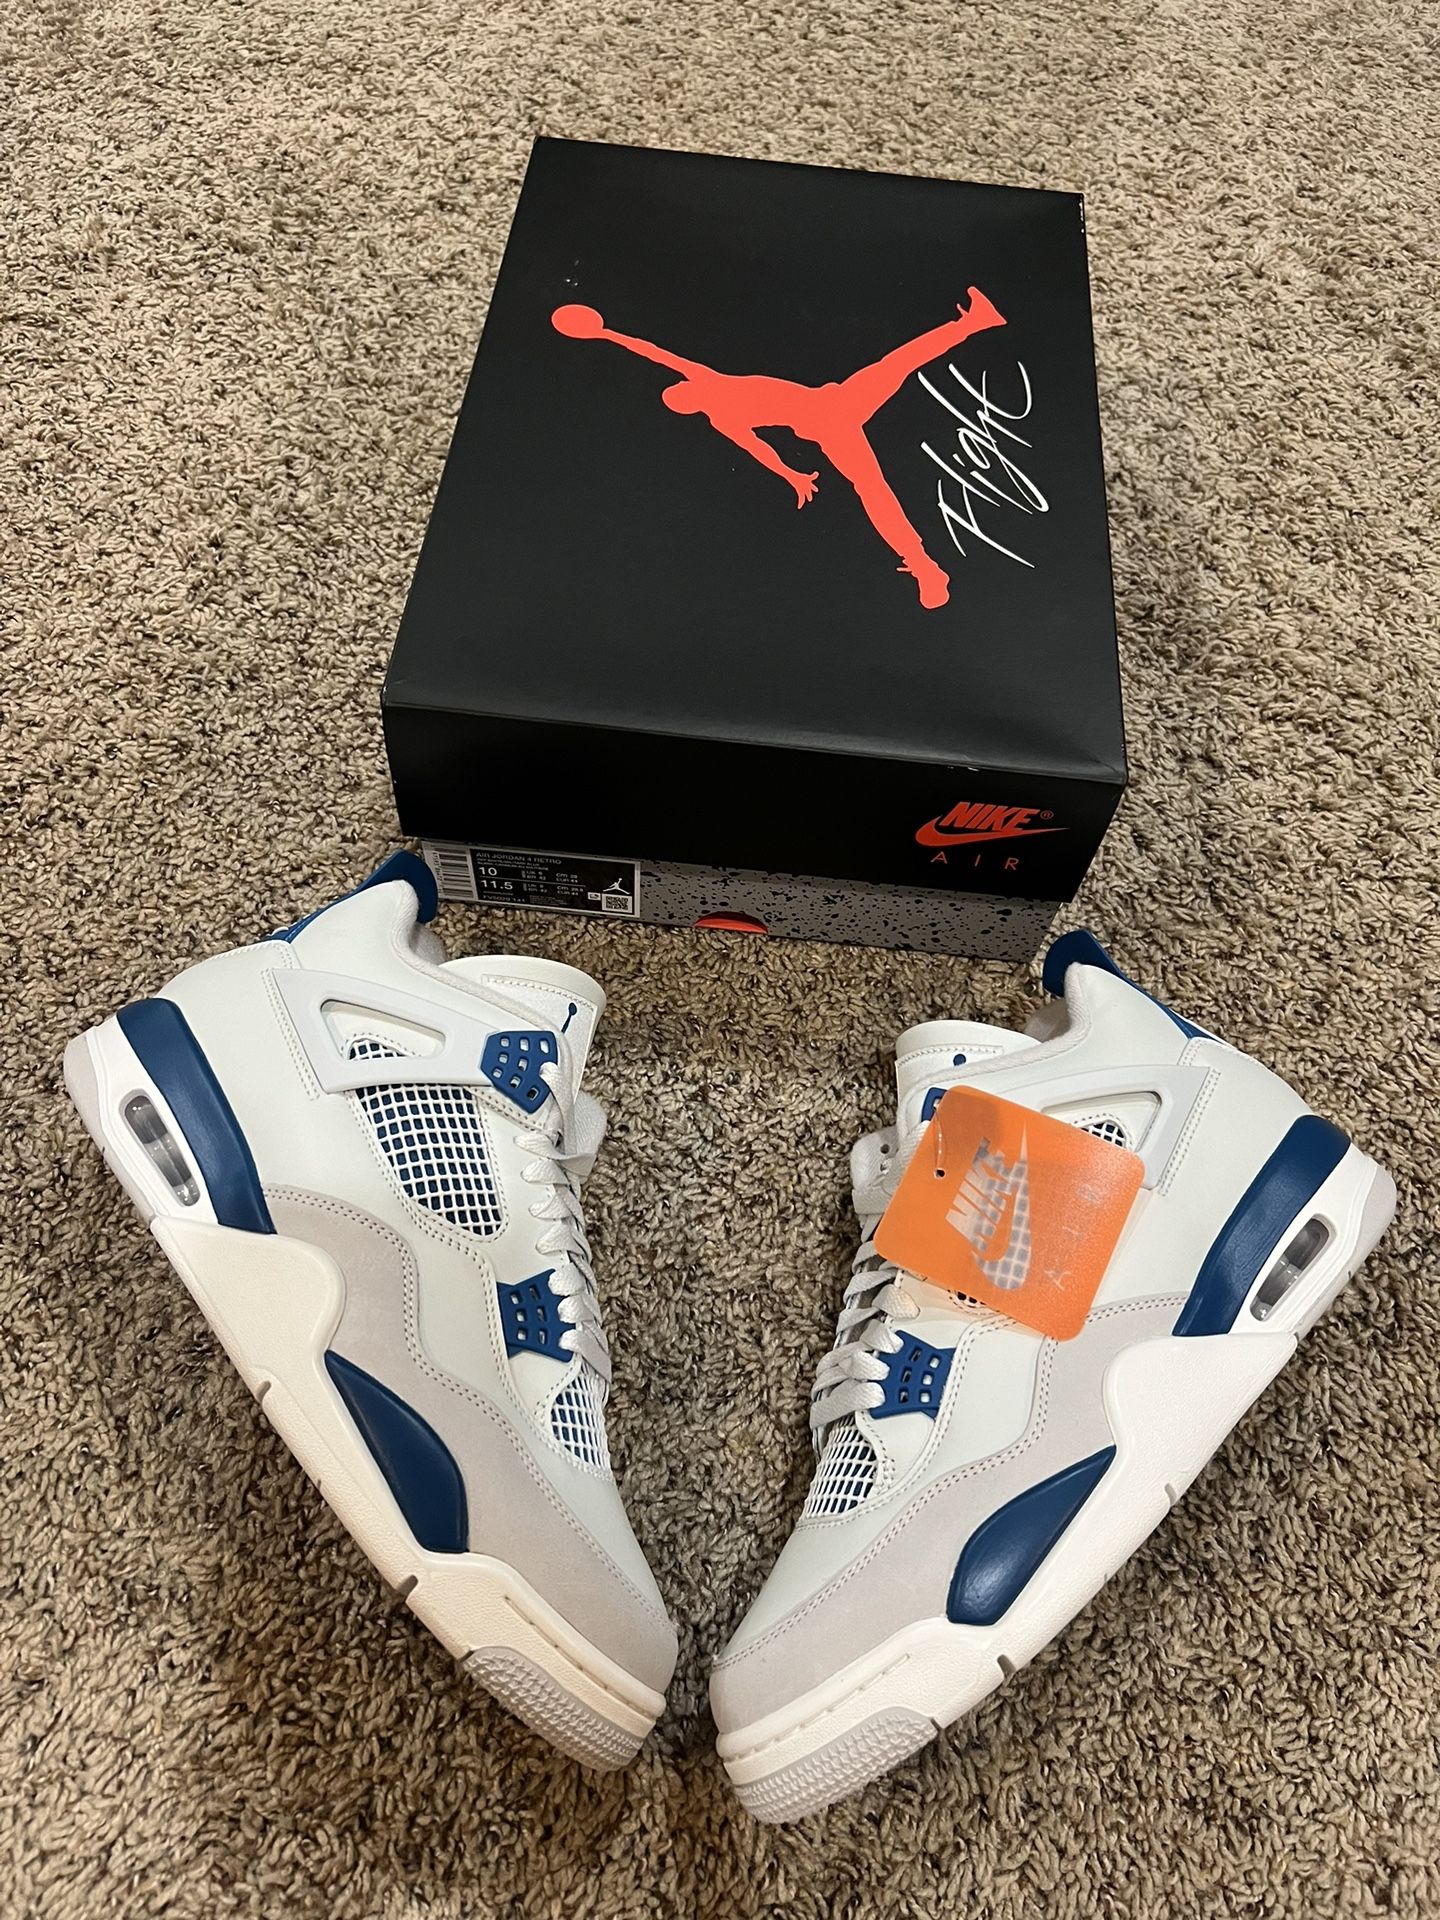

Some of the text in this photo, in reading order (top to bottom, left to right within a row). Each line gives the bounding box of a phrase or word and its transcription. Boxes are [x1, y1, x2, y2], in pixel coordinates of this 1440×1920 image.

[917, 360, 1049, 568] Flight
[938, 801, 1041, 832] NIKE
[491, 853, 525, 862] JORDAN
[533, 857, 562, 865] RETRO
[930, 851, 1019, 871] AIR
[479, 866, 498, 876] 10
[481, 879, 513, 890] 11.5
[945, 1137, 1013, 1251] NIKE
